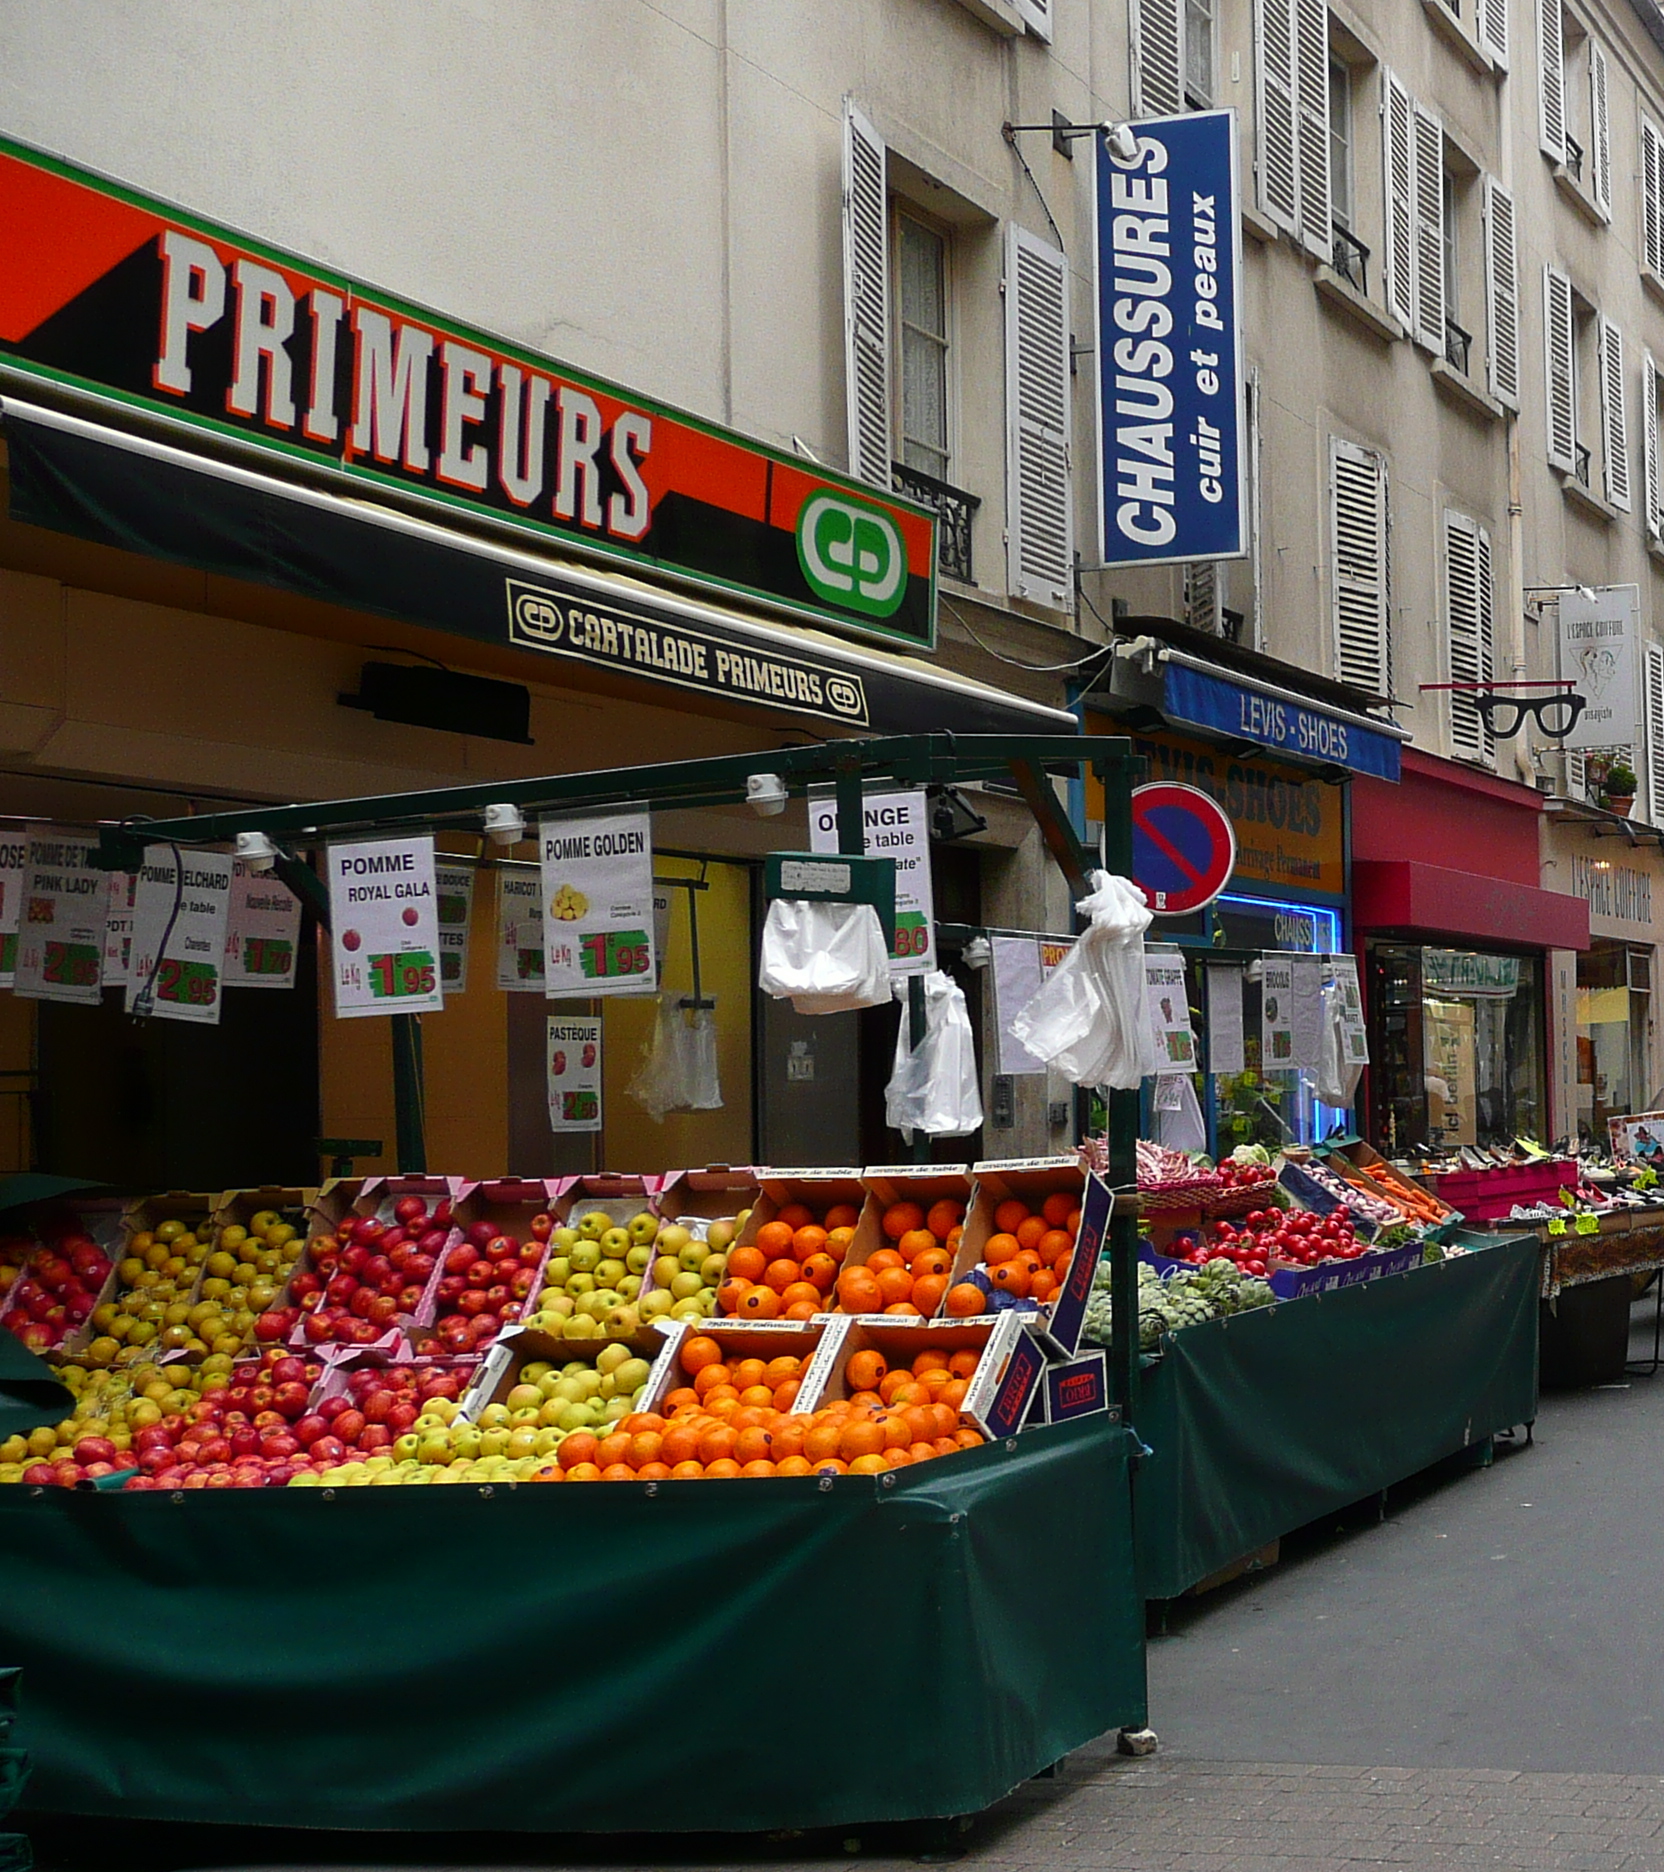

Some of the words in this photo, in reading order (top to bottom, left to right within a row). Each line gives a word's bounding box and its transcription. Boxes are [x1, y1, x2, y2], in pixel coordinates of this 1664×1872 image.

[1192, 191, 1224, 331] peaux
[1109, 136, 1176, 546] CHAUSSURES
[1189, 347, 1220, 396] et
[153, 229, 651, 543] PRIMEURS
[1190, 417, 1223, 503] cuir
[568, 609, 708, 680] CARTALADE
[716, 650, 823, 705] PRIMEURS
[1240, 693, 1286, 742] LEVIS
[1298, 712, 1348, 760] SHOES
[819, 807, 910, 831] ONGE
[547, 836, 591, 861] POMME
[594, 832, 644, 857] GOLDEN
[875, 832, 914, 848] table
[0, 844, 25, 869] OSE
[341, 854, 415, 876] POMME
[34, 875, 62, 892] PINK
[66, 876, 99, 894] LADY
[141, 865, 176, 884] POMME
[182, 870, 229, 890] ELCHARD
[348, 885, 391, 902] ROYAL
[395, 882, 430, 899] GALA
[190, 900, 216, 915] table
[550, 1023, 597, 1041] PASTÈQUE
